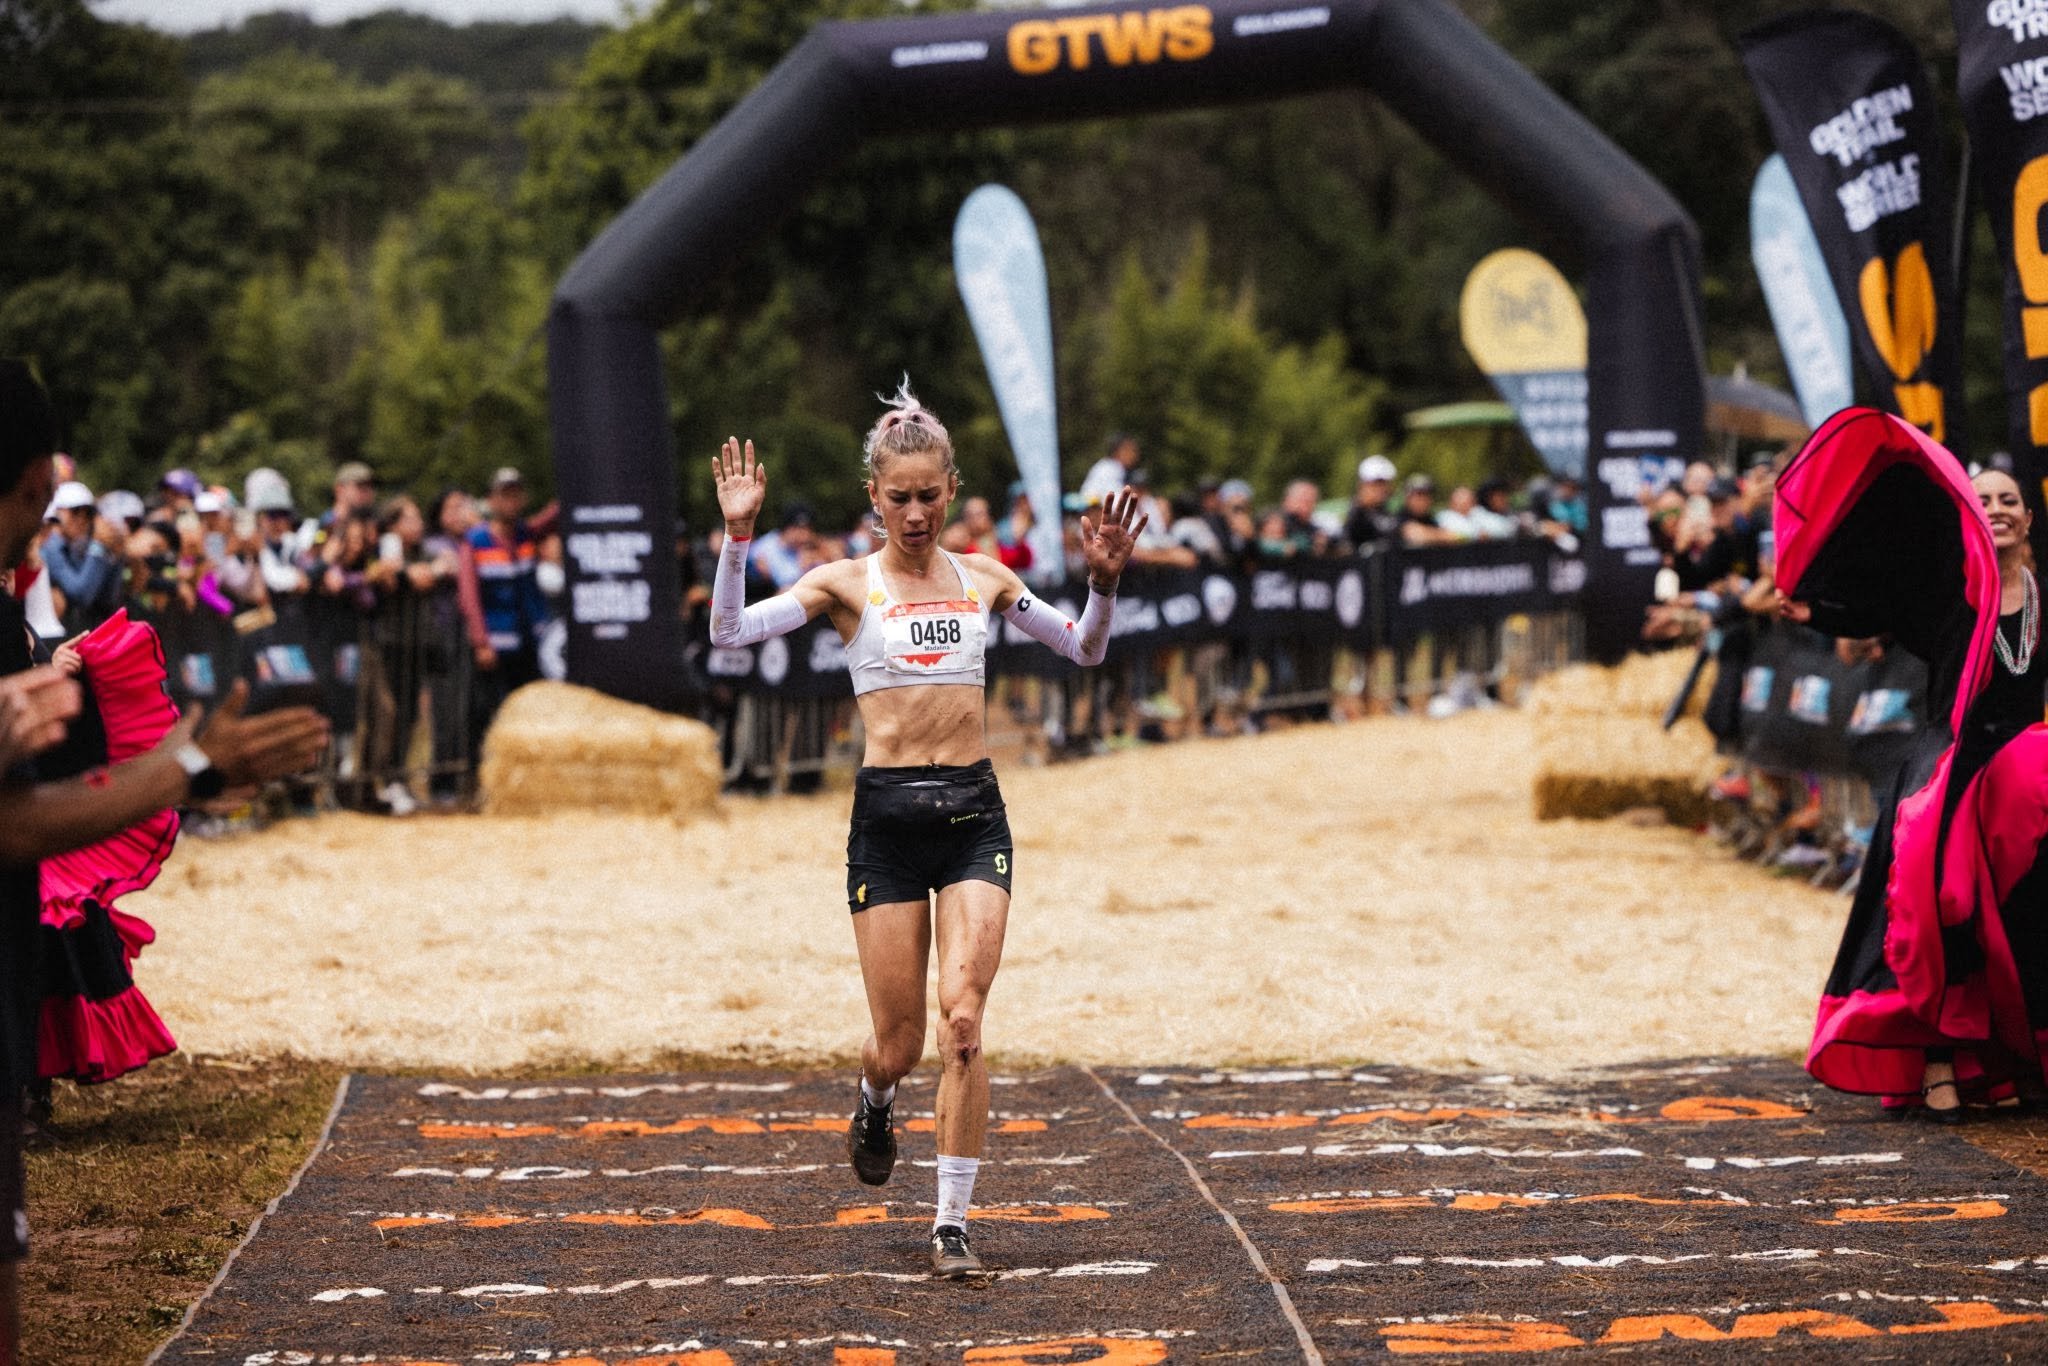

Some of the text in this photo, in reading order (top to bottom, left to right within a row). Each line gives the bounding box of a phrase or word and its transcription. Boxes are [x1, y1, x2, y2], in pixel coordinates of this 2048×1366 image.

[1987, 0, 2048, 27] GO
[1007, 5, 1214, 74] GTWS
[911, 619, 961, 645] 0458
